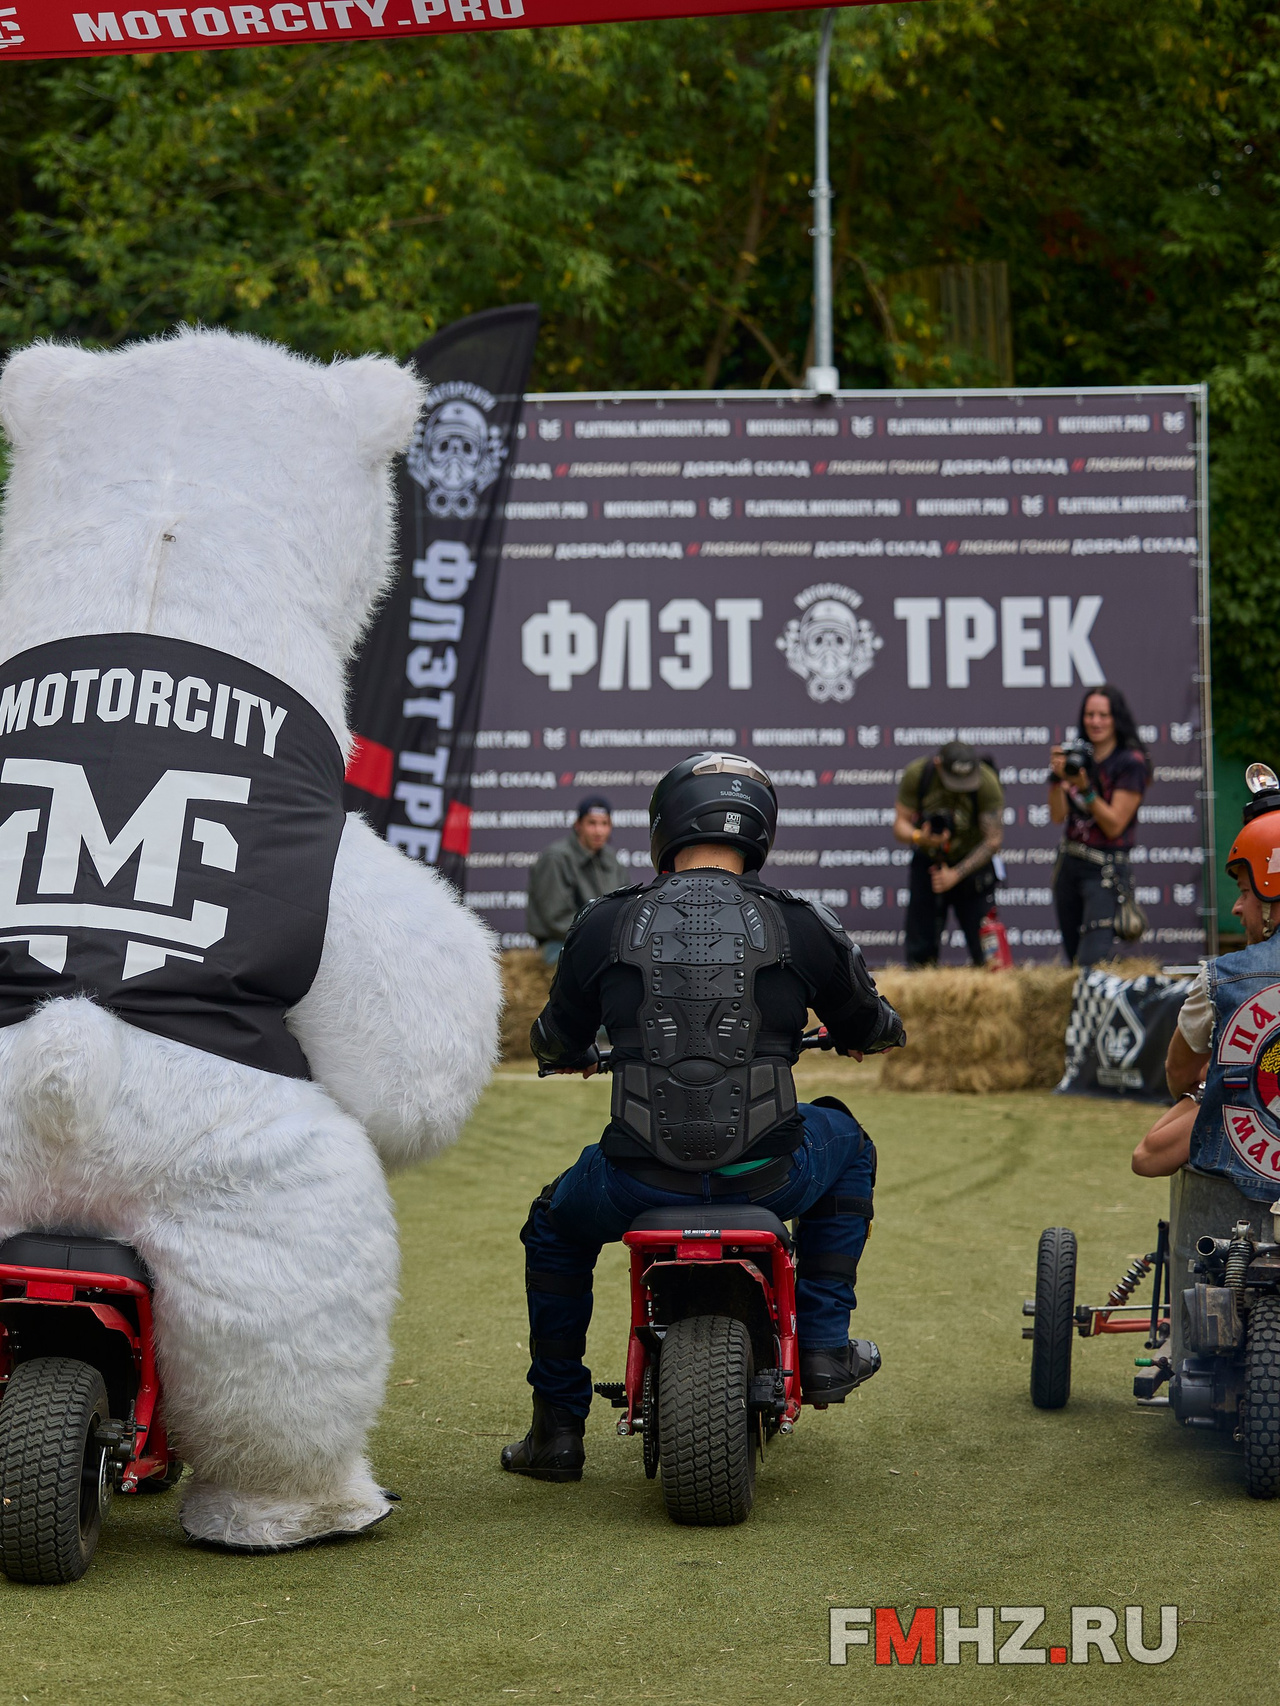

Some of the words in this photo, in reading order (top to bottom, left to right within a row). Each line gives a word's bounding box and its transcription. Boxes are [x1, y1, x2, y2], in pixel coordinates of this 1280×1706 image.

[72, 0, 524, 42] MOTORCITY.PRO
[510, 463, 552, 480] ЛАД
[569, 461, 629, 478] ЛЮБИМ
[630, 461, 681, 477] ГОНКИ
[682, 458, 752, 479] ДОБРЫЙ
[753, 460, 811, 479] СКЛАД
[827, 459, 887, 476] ЛЮБИМ
[888, 458, 940, 475] ГОНКИ
[940, 456, 1011, 477] ДОБРЫЙ
[1012, 457, 1069, 476] СКЛАД
[1084, 456, 1145, 473] ЛЮБИМ
[505, 501, 588, 520] OTORCITY.PRO
[555, 540, 625, 561] ДОБРЫЙ
[626, 542, 683, 560] СКЛАД
[700, 541, 760, 557] ЛЮБИМ
[761, 541, 813, 556] ГОНКИ
[813, 538, 883, 559] ДОБРЫЙ
[884, 540, 941, 558] СКЛАД
[958, 538, 1018, 555] ЛЮБИМ
[1019, 538, 1070, 555] ГОНКИ
[1071, 535, 1141, 556] ДОБРЫЙ
[1142, 537, 1198, 555] СКЛАД
[403, 539, 477, 730] ФЛЭТ
[521, 598, 763, 692] ФЛЭТ
[894, 595, 1107, 689] ТРЕК
[894, 726, 1049, 746] FLATTRACKMOTORCITY.PRO
[499, 771, 557, 790] СКЛАД
[574, 770, 634, 787] ЛЮБИМ
[635, 770, 669, 787] ГОН
[833, 769, 894, 786] ЛЮБИМ
[385, 746, 451, 864] ТРЕ
[819, 847, 889, 868] ДОБРЫЙ
[1149, 847, 1205, 864] СКЛАД
[1229, 993, 1280, 1055] ПА
